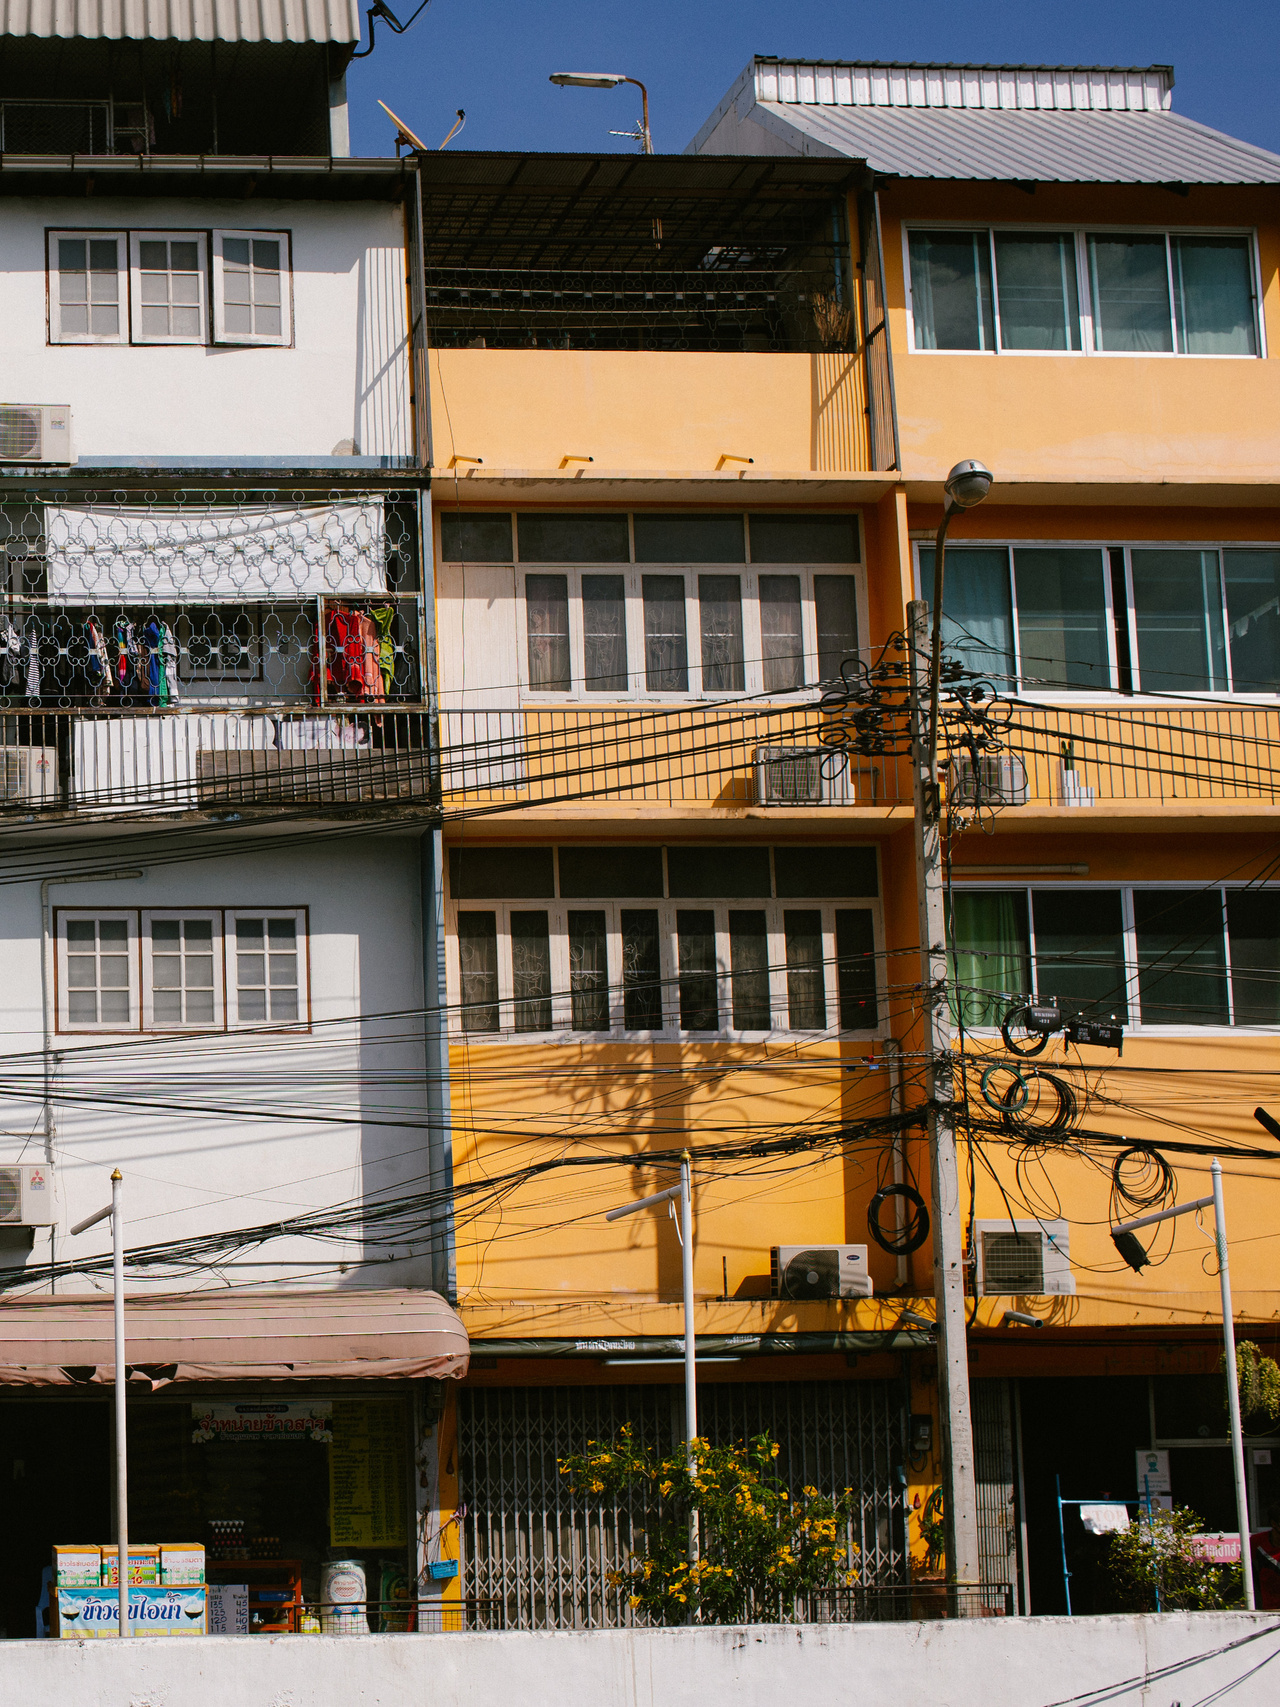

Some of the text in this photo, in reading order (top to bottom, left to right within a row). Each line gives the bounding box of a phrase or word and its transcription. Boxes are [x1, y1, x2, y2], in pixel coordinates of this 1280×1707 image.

[199, 1413, 325, 1432] จำหน่ายข้าวสาร
[111, 1567, 118, 1575] 2
[134, 1566, 141, 1575] 7
[131, 1576, 143, 1584] 10
[210, 1600, 223, 1609] 135
[210, 1608, 248, 1616] 125 42
[211, 1616, 248, 1625] 120 40
[211, 1624, 247, 1634] 115 39
